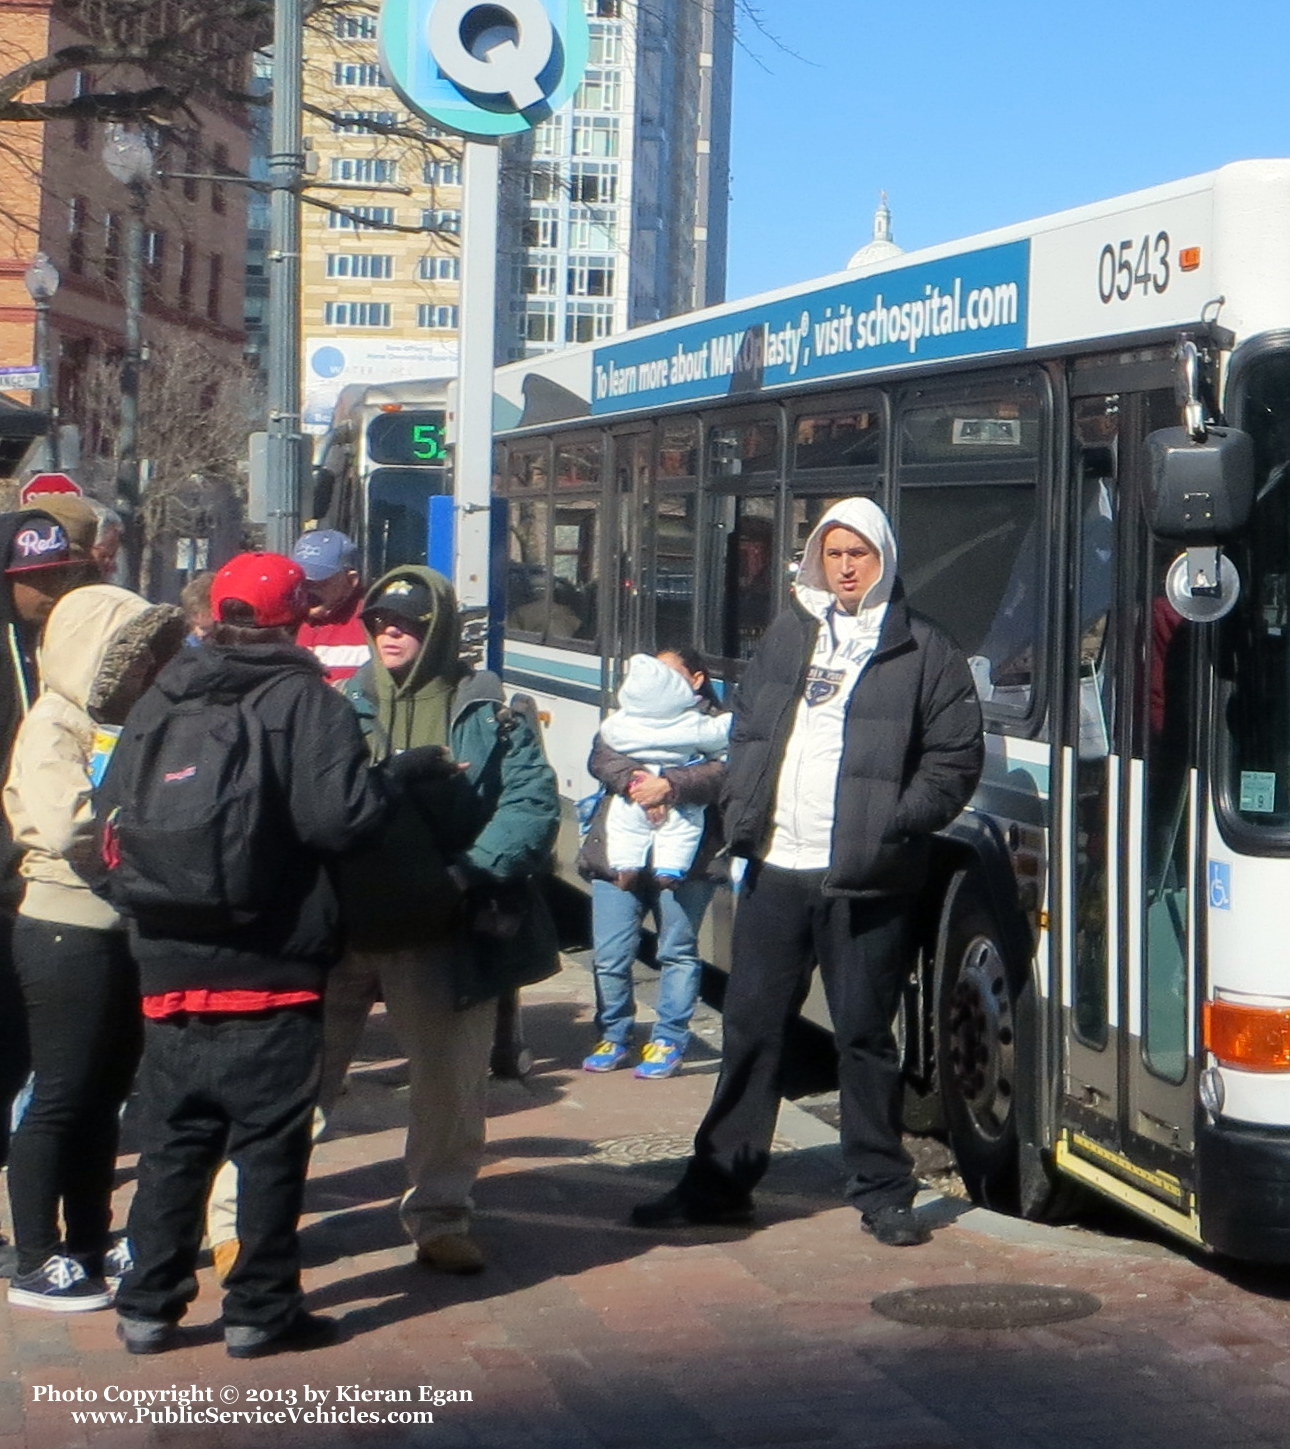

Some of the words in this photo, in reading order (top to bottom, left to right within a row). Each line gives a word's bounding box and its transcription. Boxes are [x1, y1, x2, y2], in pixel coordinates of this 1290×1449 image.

[428, 0, 552, 110] Q
[1098, 231, 1170, 304] 0543
[595, 364, 608, 399] To
[608, 360, 637, 397] learn
[639, 358, 668, 392] more
[670, 343, 708, 385] about
[814, 304, 854, 357] visit
[856, 277, 1019, 353] schospital.com
